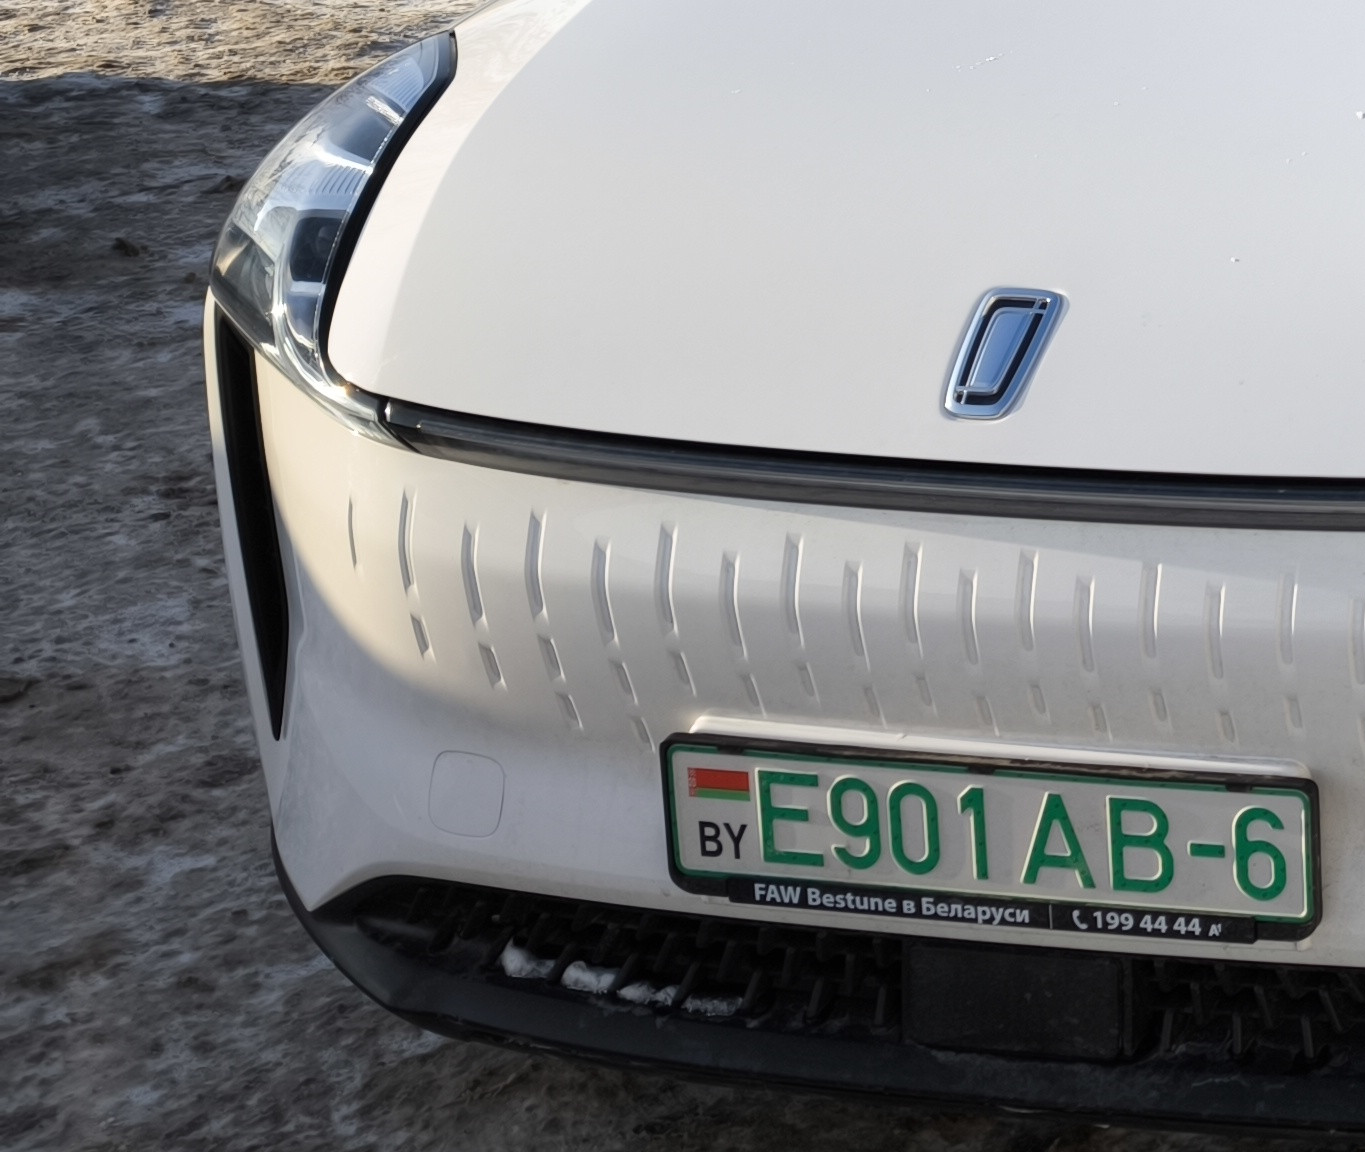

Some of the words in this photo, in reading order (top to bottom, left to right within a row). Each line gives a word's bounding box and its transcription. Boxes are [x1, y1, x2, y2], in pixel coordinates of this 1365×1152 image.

[698, 820, 748, 860] BY
[753, 883, 801, 904] FAW
[806, 887, 897, 914] Bestune
[902, 900, 916, 915] в
[921, 897, 1030, 926] Беларуси
[1092, 911, 1134, 931] 199
[1139, 914, 1168, 934] 44
[1173, 916, 1202, 936] 44
